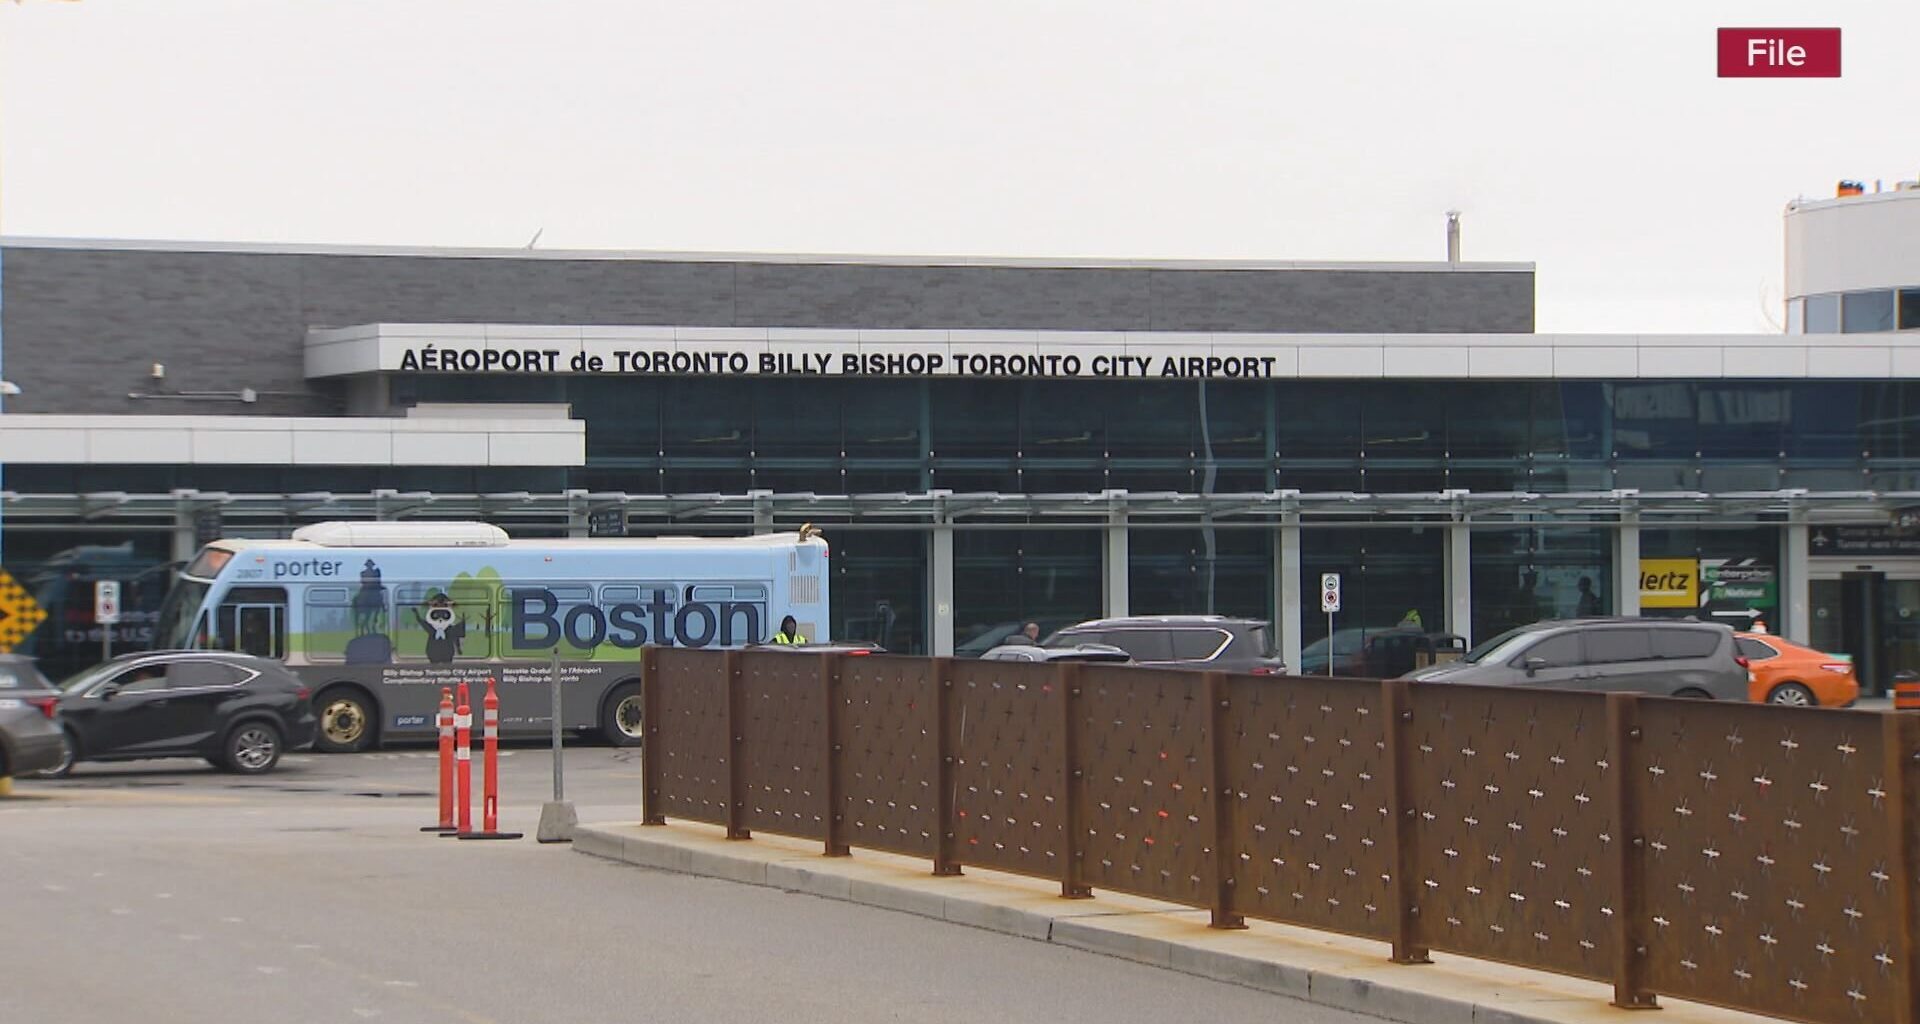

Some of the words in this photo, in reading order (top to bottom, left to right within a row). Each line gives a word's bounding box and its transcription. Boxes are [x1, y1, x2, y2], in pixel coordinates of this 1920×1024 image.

[400, 344, 560, 372] AÉROPORT
[570, 350, 603, 371] de
[613, 351, 748, 374] TORONTO
[759, 353, 832, 374] BILLY
[842, 353, 943, 375] BISHOP
[953, 354, 1081, 376] TORONTO
[1091, 356, 1152, 377] CITY
[1161, 356, 1276, 377] AIRPORT
[274, 558, 343, 580] porter
[1726, 588, 1765, 598] National
[512, 588, 759, 648] Boston
[467, 669, 492, 677] Airport
[397, 715, 425, 727] porter
